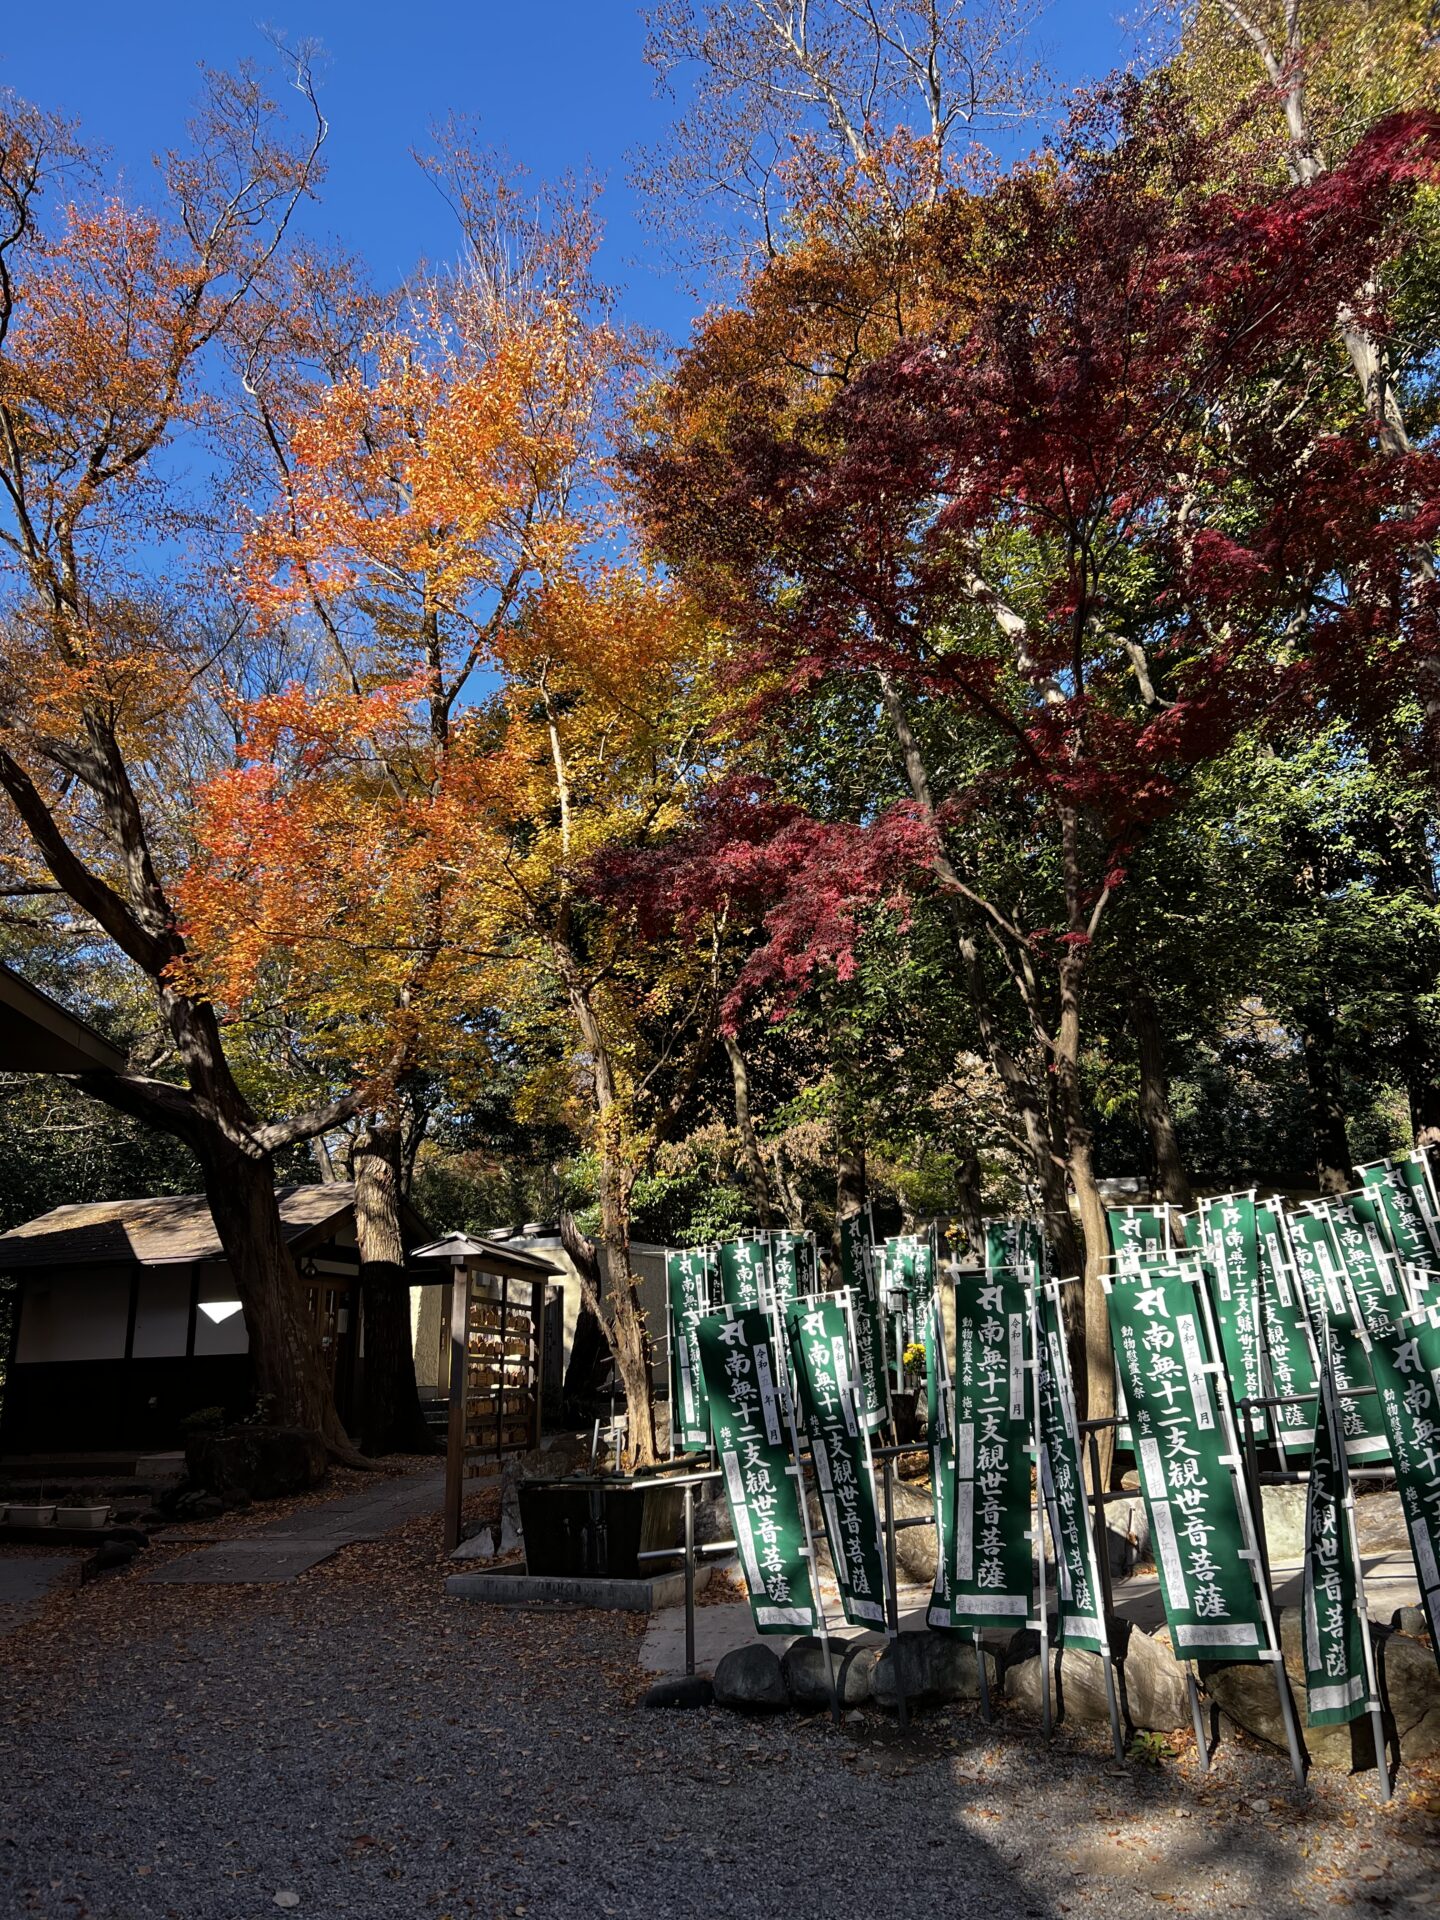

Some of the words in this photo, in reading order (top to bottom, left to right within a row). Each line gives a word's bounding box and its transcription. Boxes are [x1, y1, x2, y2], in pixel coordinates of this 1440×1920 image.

[724, 1351, 793, 1603] 南無十二支観世音菩薩
[807, 1340, 872, 1595] 南無十二支観世音菩薩
[962, 1396, 973, 1419] 施主
[975, 1315, 1009, 1589] 南無十二支観世音菩薩
[1121, 1325, 1147, 1400] 動物慰霊大祭
[1136, 1410, 1152, 1435] 施主
[1141, 1322, 1232, 1618] 南無十二支観世音菩薩
